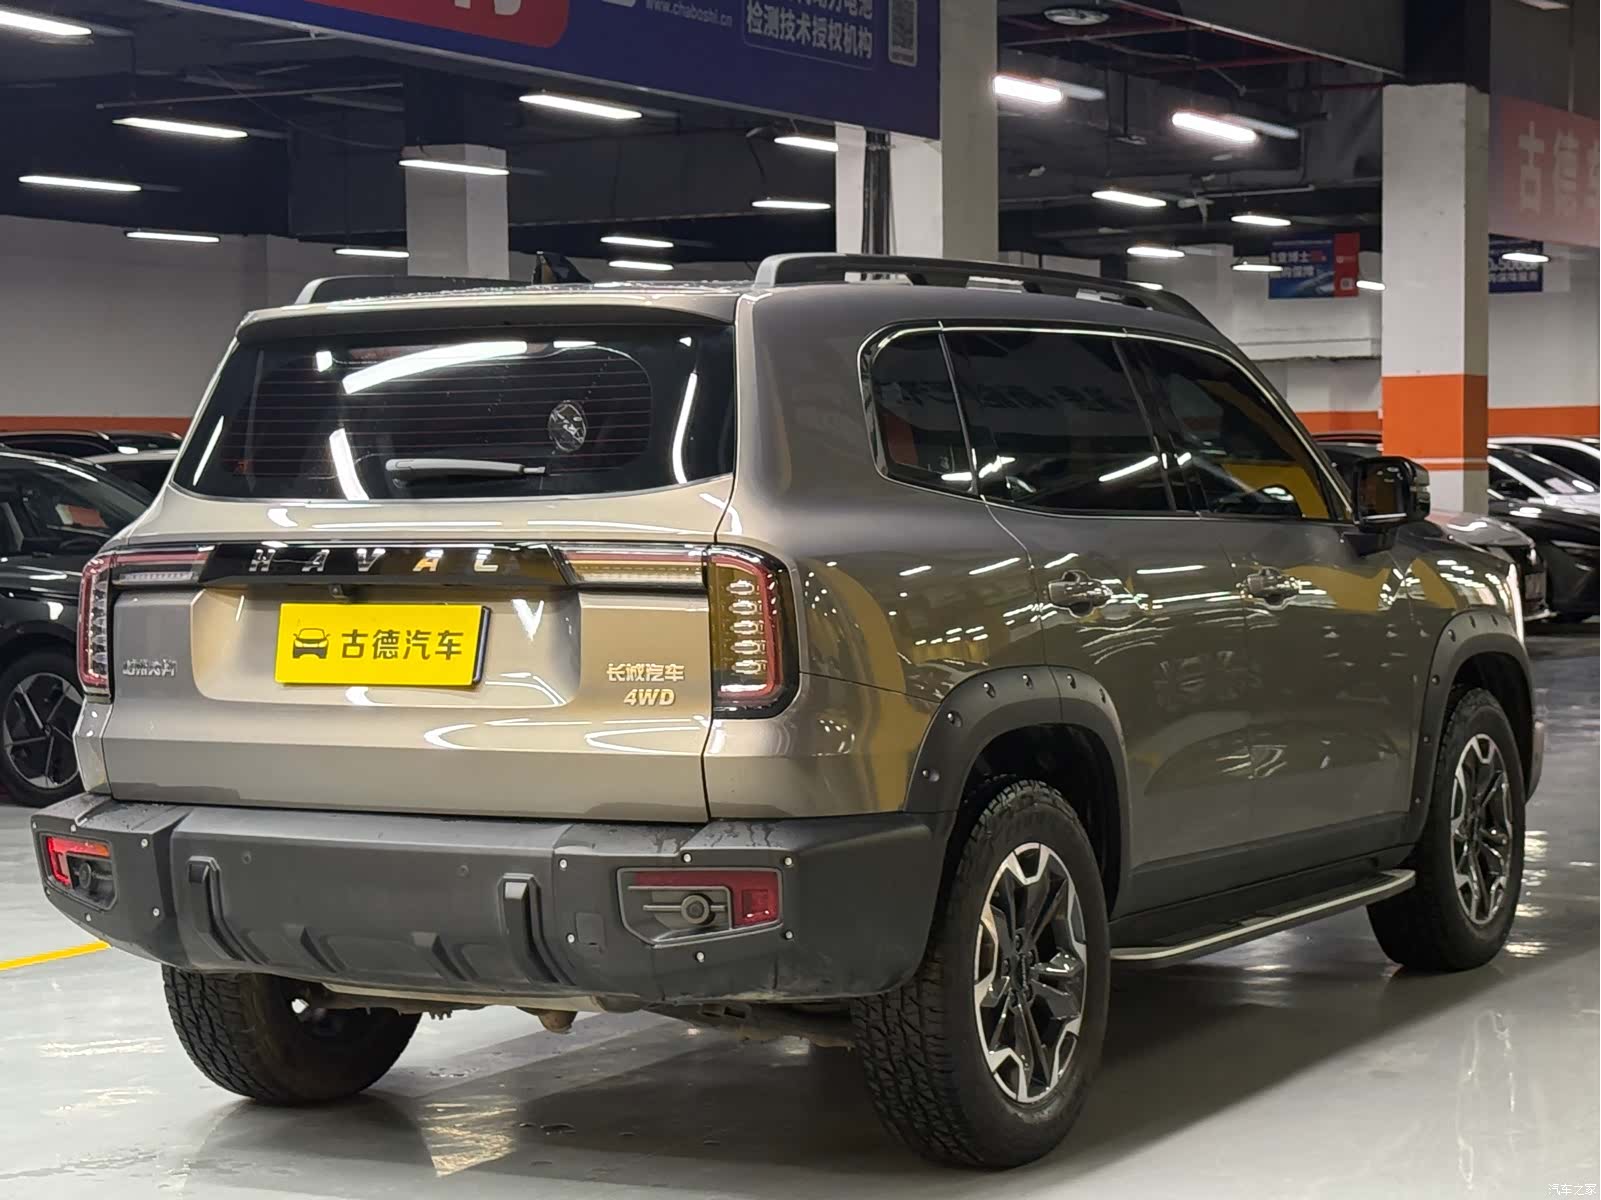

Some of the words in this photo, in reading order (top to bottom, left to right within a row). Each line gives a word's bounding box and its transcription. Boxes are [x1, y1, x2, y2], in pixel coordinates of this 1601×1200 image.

[746, 1, 873, 59] 检测技术授权机构
[249, 549, 498, 572] HAVAL
[341, 624, 464, 660] 古德汽车
[606, 663, 685, 682] 长城汽车
[623, 689, 675, 706] 4WD
